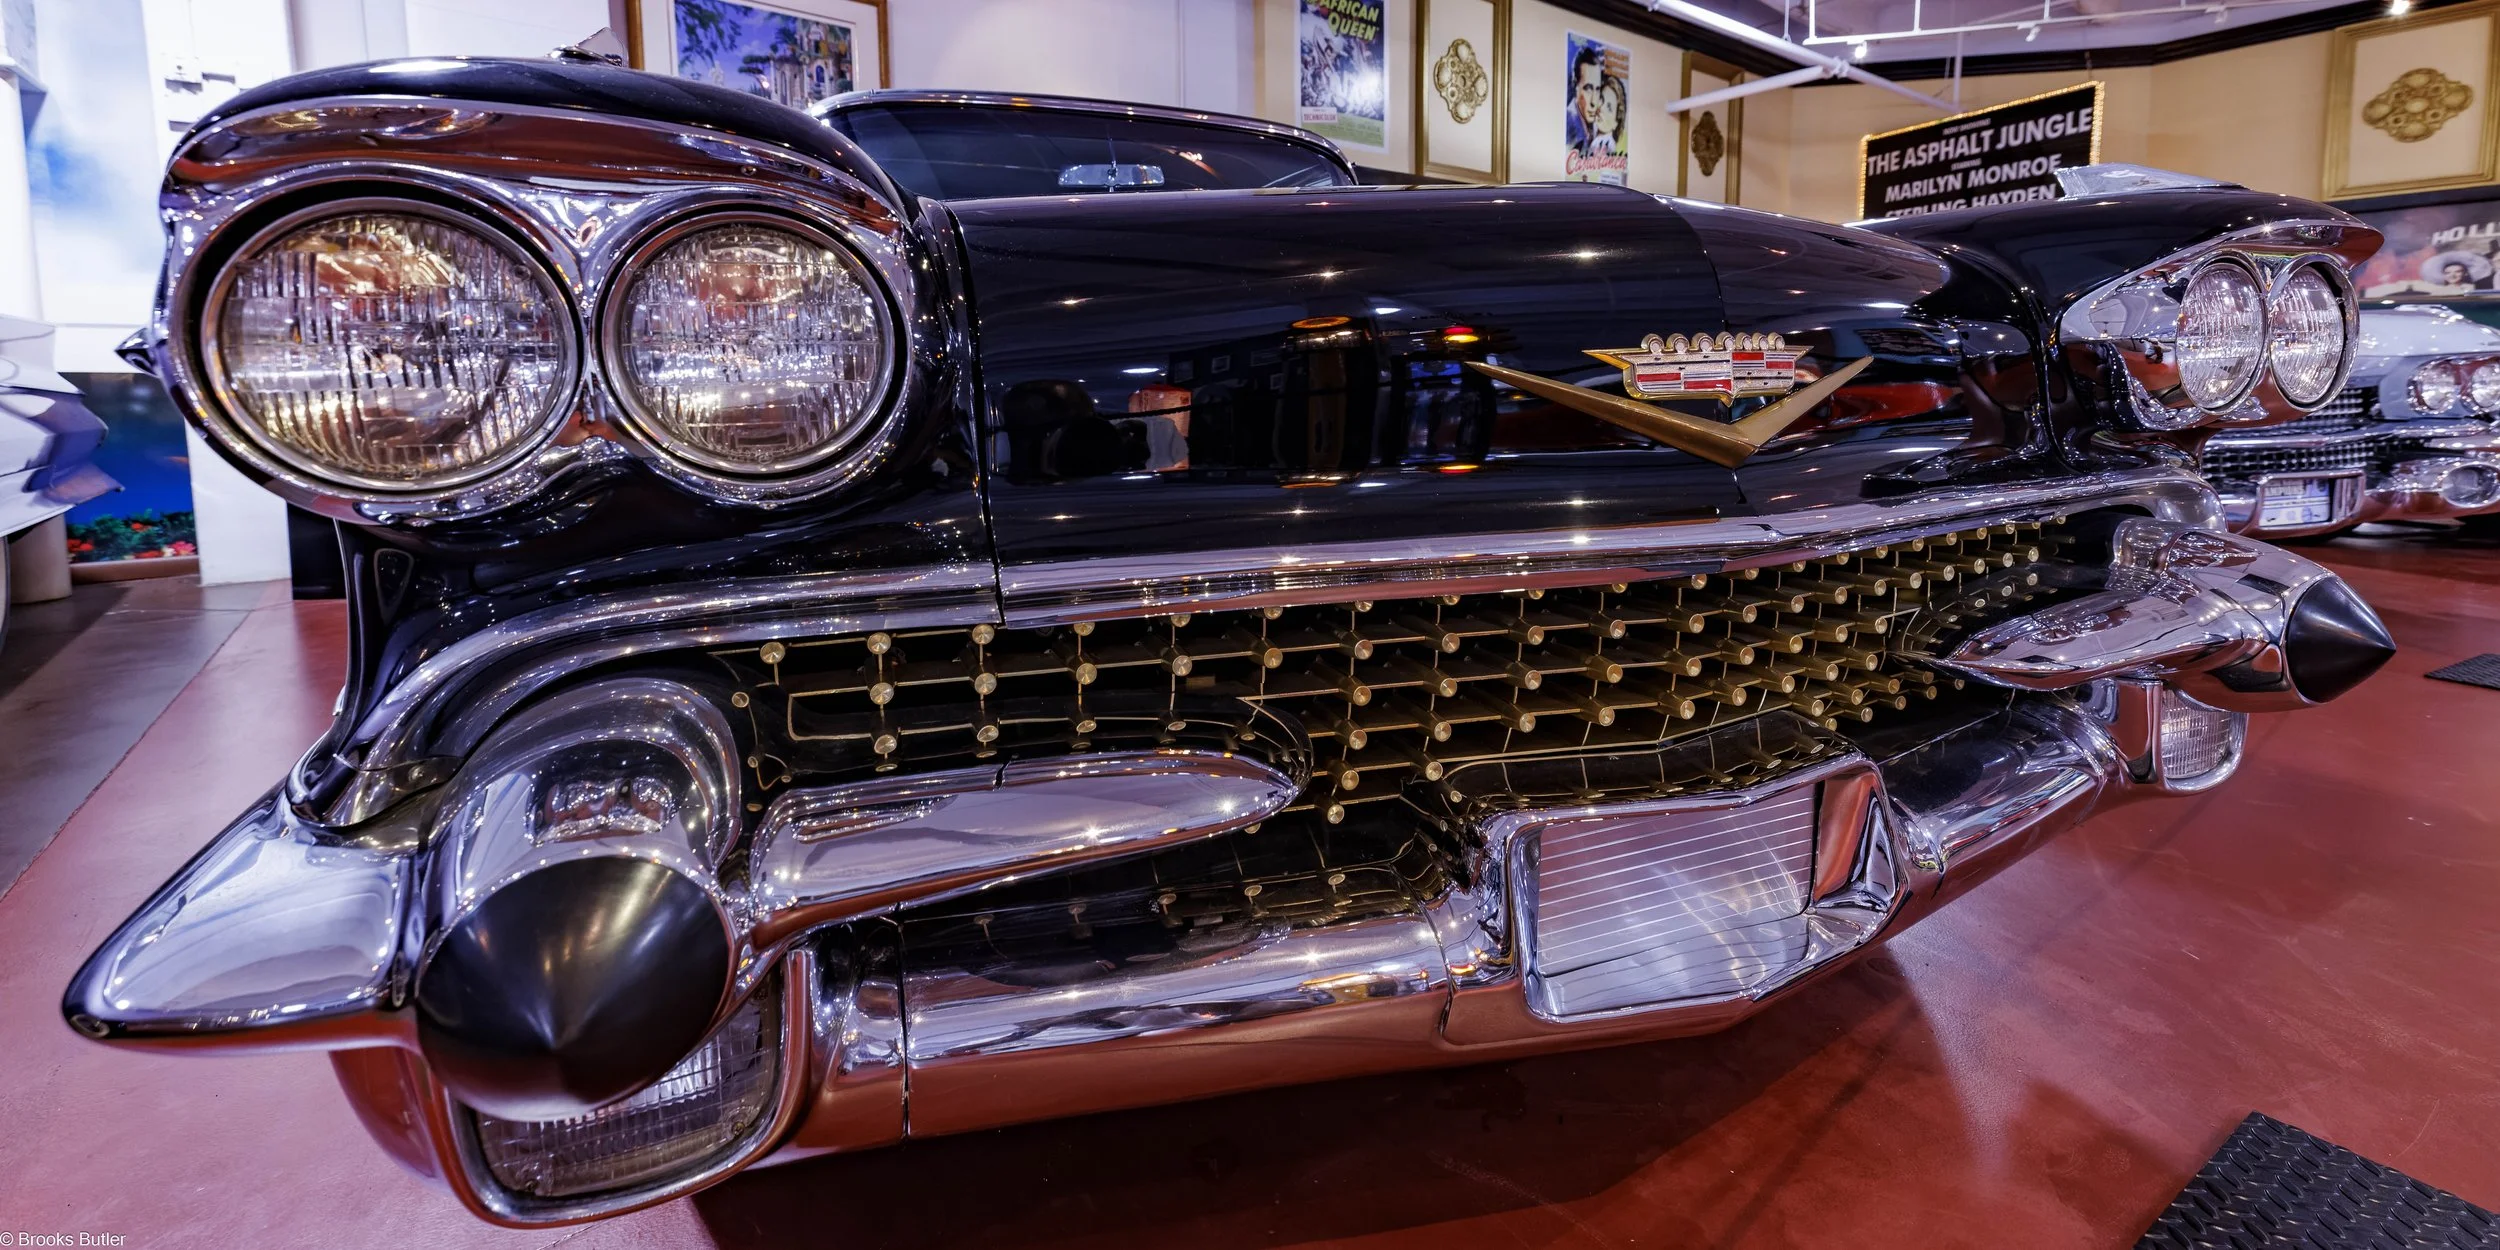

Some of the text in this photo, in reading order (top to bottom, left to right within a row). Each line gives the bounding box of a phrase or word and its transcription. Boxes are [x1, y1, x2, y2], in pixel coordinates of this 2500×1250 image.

[1320, 0, 1379, 22] AFRICAN
[1328, 12, 1376, 41] QUEEN
[1868, 107, 2093, 177] THE ASPHALT JUNGLE
[1885, 154, 2062, 203] MARILYN MONROE
[1971, 184, 2056, 208] HAYDEN
[2432, 221, 2500, 246] HOLL
